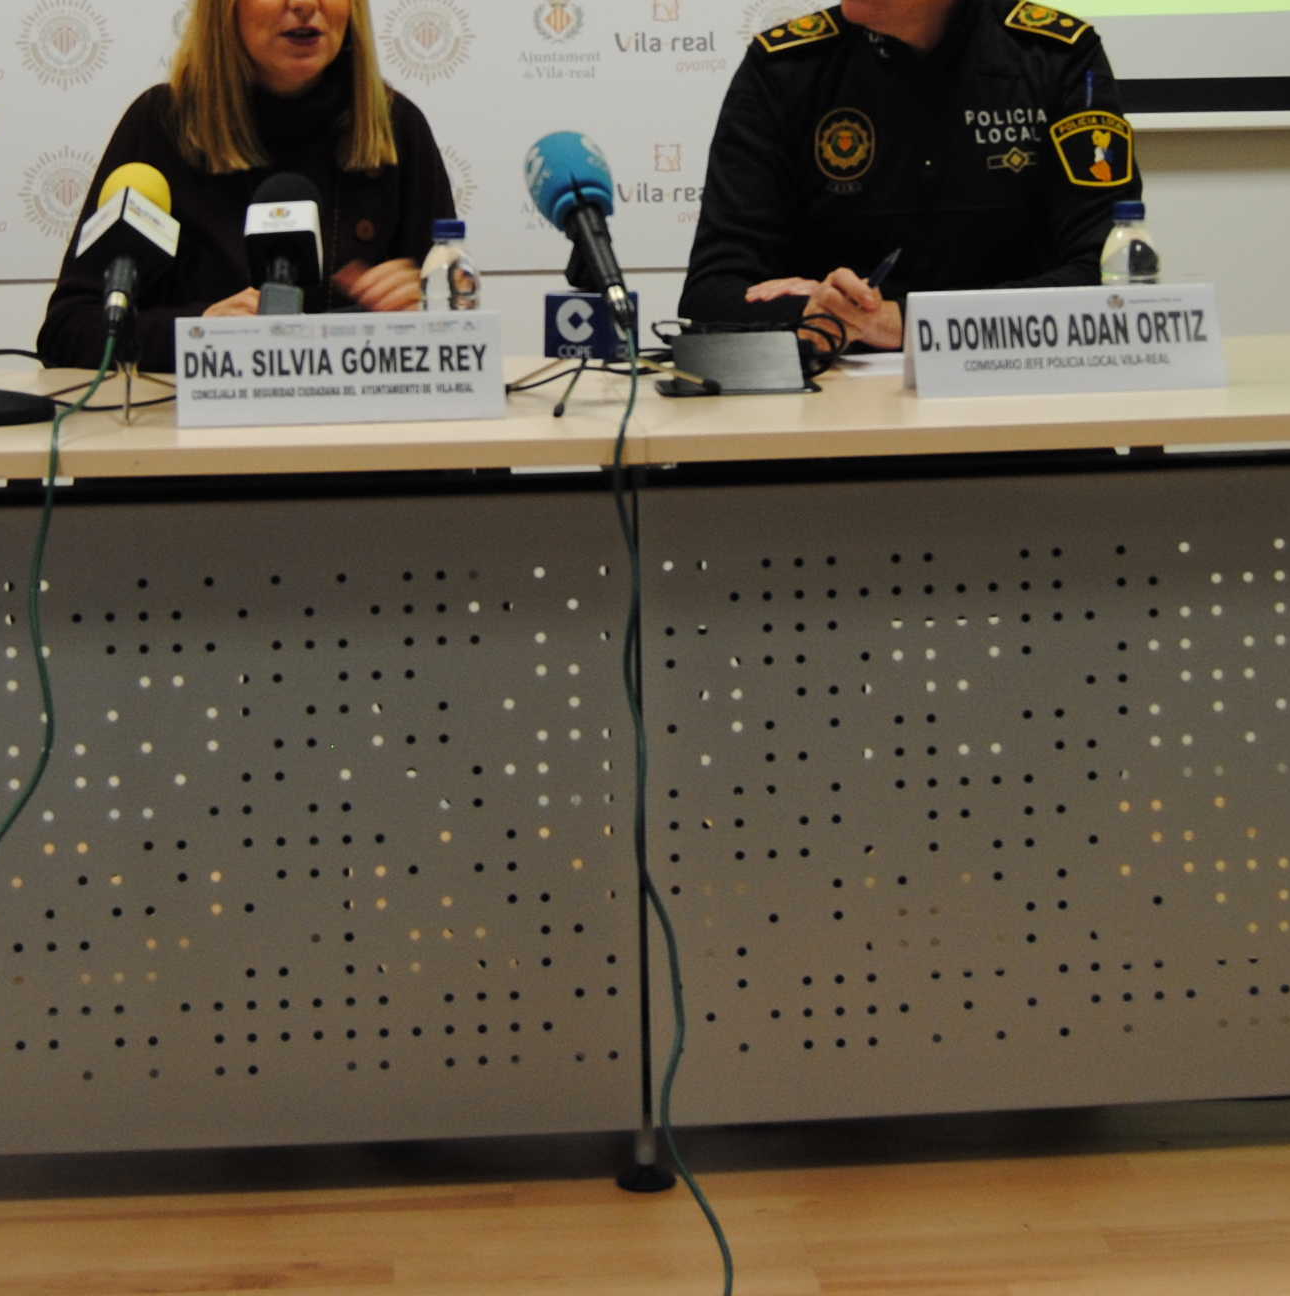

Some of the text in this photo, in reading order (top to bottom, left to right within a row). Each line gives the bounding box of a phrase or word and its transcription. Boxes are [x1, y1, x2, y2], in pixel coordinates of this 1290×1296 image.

[964, 108, 1048, 126] POLICIA
[976, 126, 1042, 144] LOCAL
[918, 309, 1207, 352] D. DOMINGO ADAN ORTIZ
[185, 340, 487, 378] DÑA. SILVIA GÓMEZ REY
